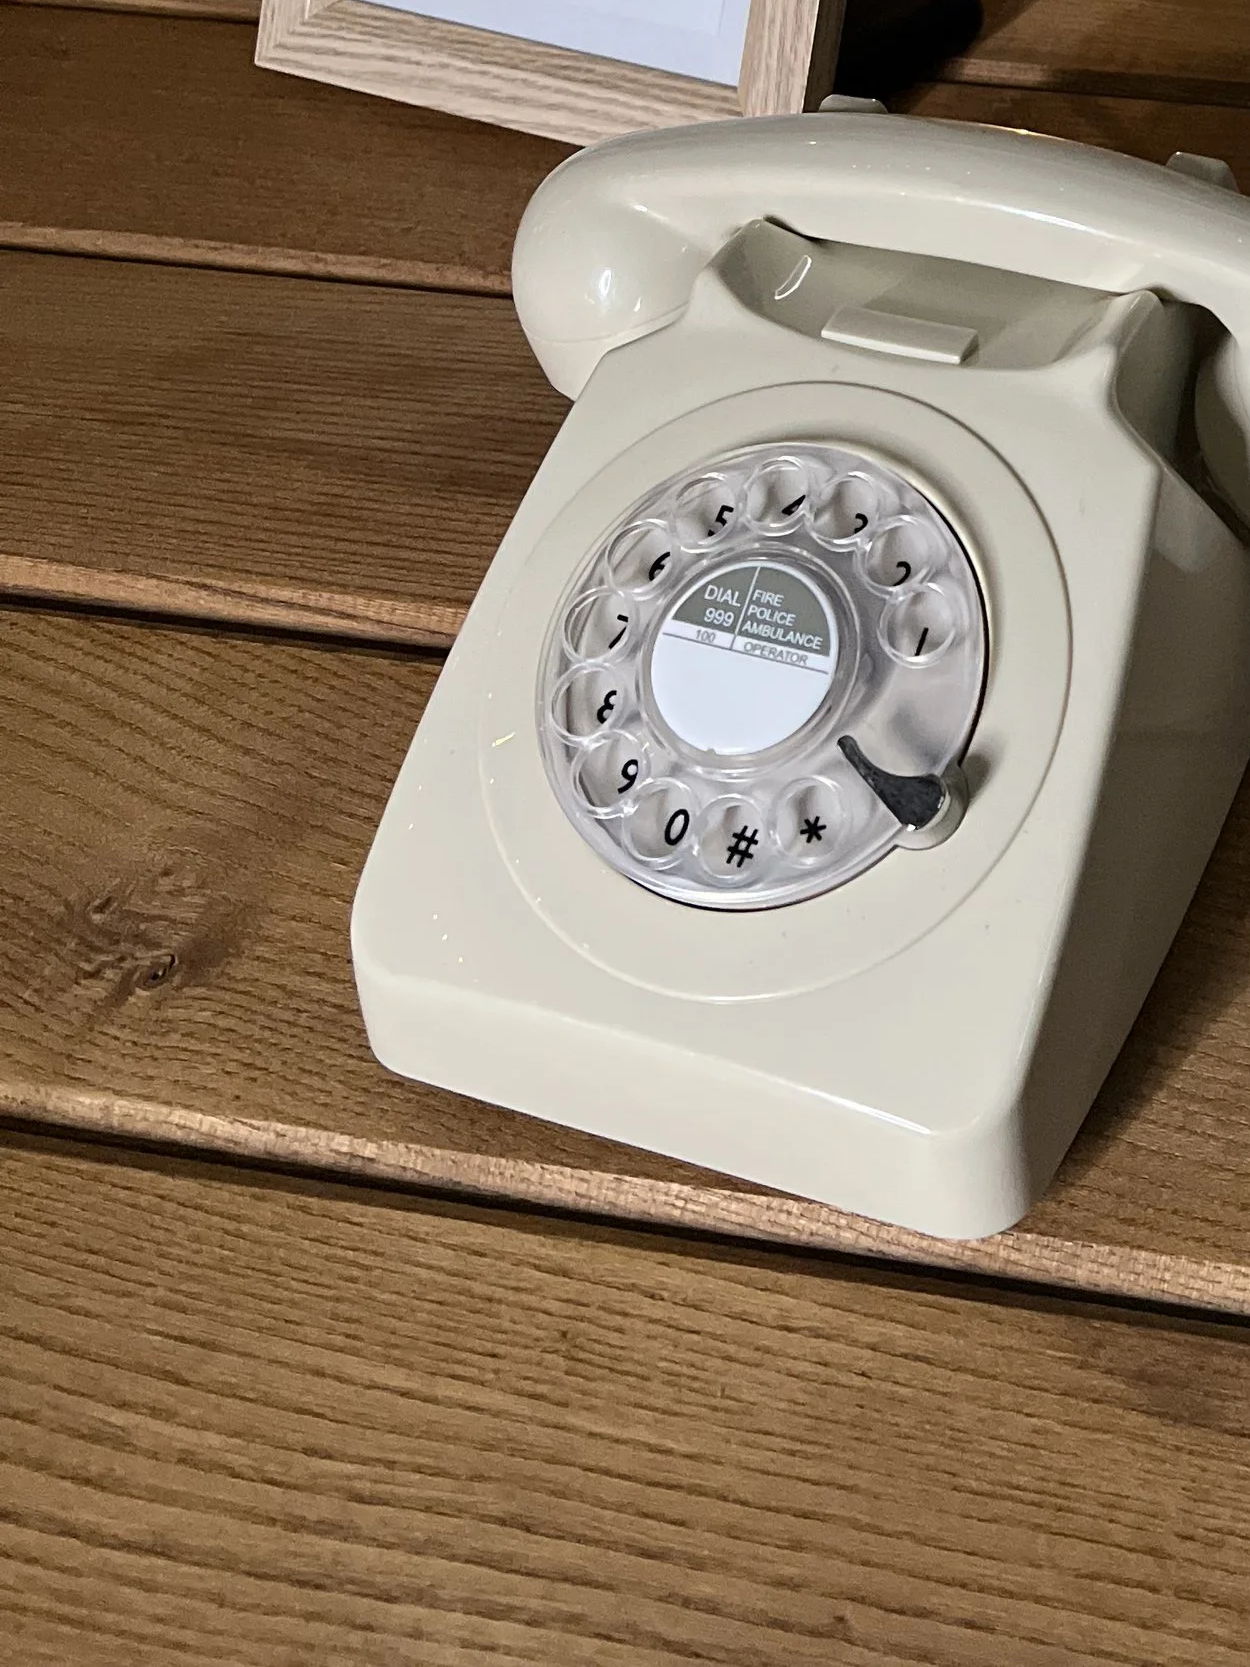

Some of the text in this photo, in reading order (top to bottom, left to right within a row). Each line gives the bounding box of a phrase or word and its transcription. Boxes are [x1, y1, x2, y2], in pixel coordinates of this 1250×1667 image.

[707, 504, 734, 537] 5
[703, 584, 741, 607] DIAL
[752, 588, 784, 608] FIRE
[703, 607, 735, 628] 999
[747, 605, 796, 628] POLICE
[695, 628, 716, 644] 100
[741, 620, 823, 650] AMBULANCE
[914, 627, 929, 657] 1
[743, 641, 808, 666] OPERATOR
[616, 758, 639, 795] 9
[664, 808, 690, 846] 0
